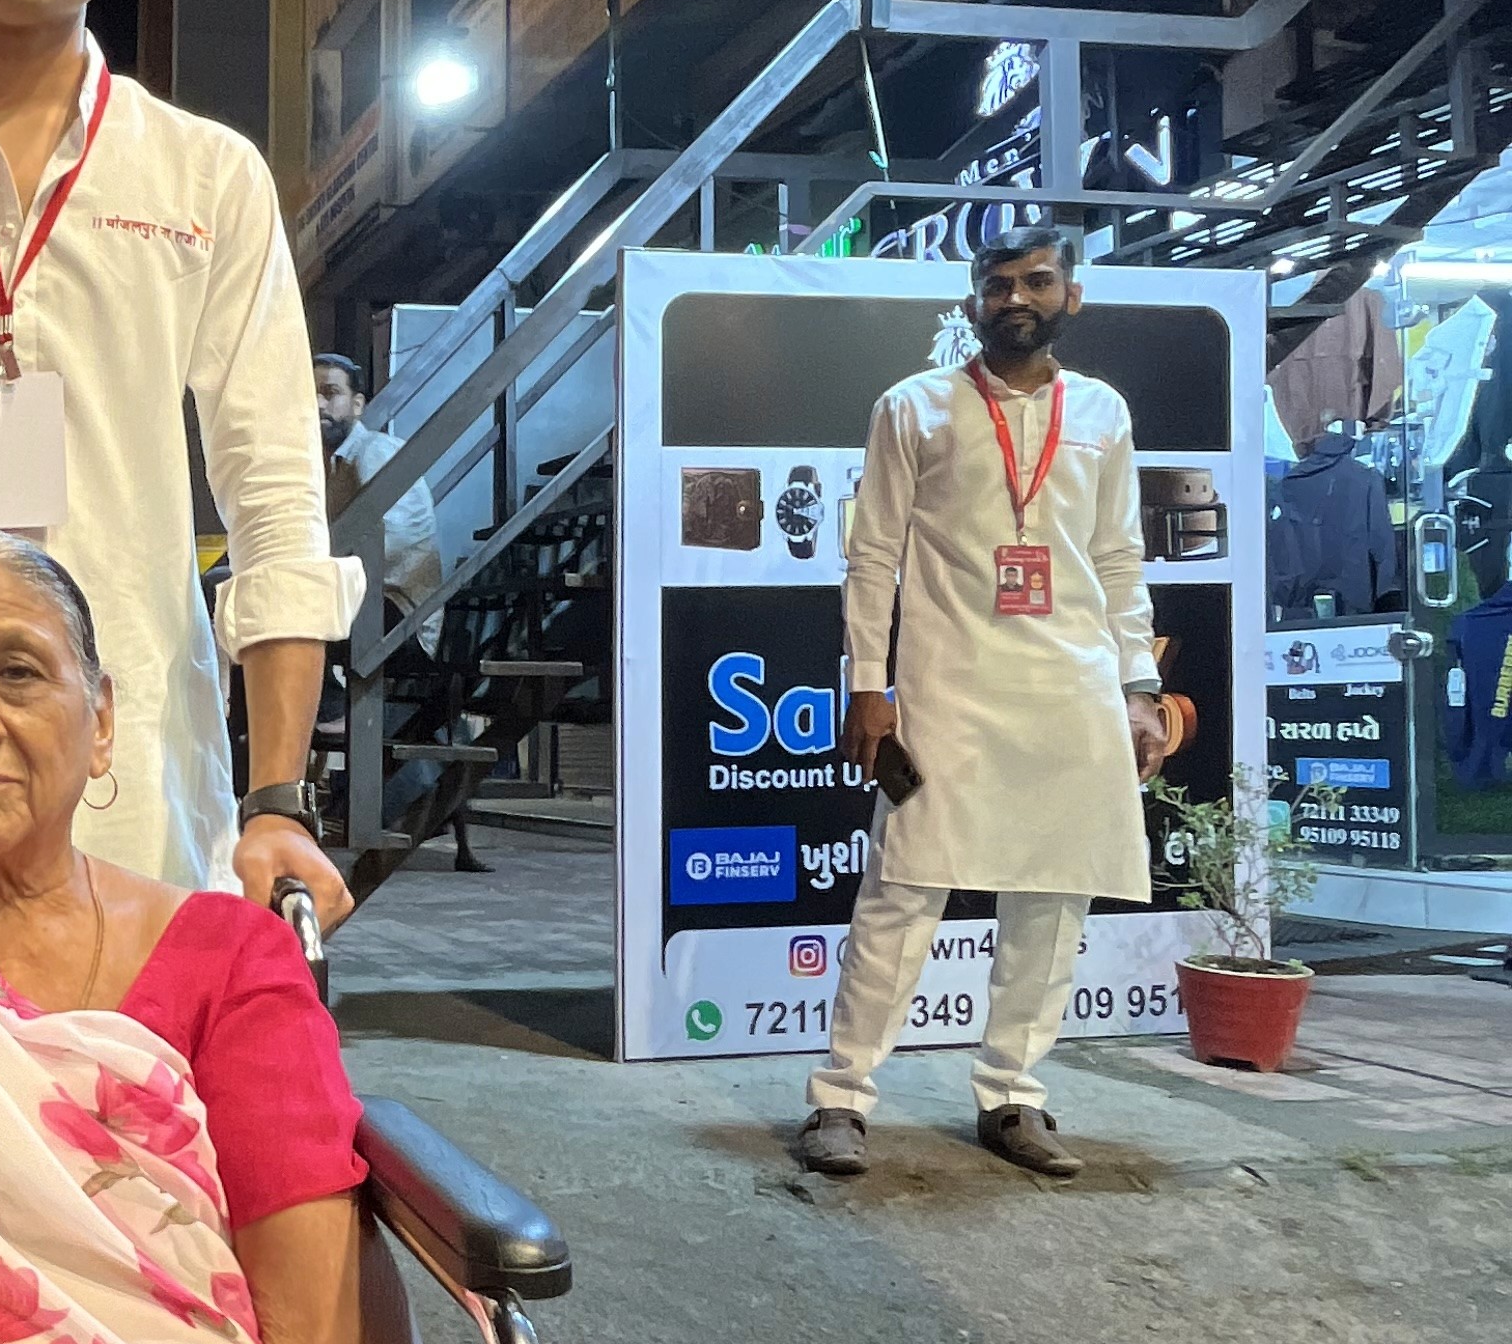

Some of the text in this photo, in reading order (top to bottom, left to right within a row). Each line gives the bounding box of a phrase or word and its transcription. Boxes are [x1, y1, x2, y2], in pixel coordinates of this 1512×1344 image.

[707, 650, 896, 757] Sa
[708, 760, 879, 792] Discount U
[1349, 805, 1401, 824] 33349
[1299, 826, 1401, 850] 95109 95118
[715, 851, 781, 866] BAJAJ
[715, 864, 780, 879] FINSERV
[1127, 984, 1183, 1018] 951
[745, 998, 827, 1036] 7211
